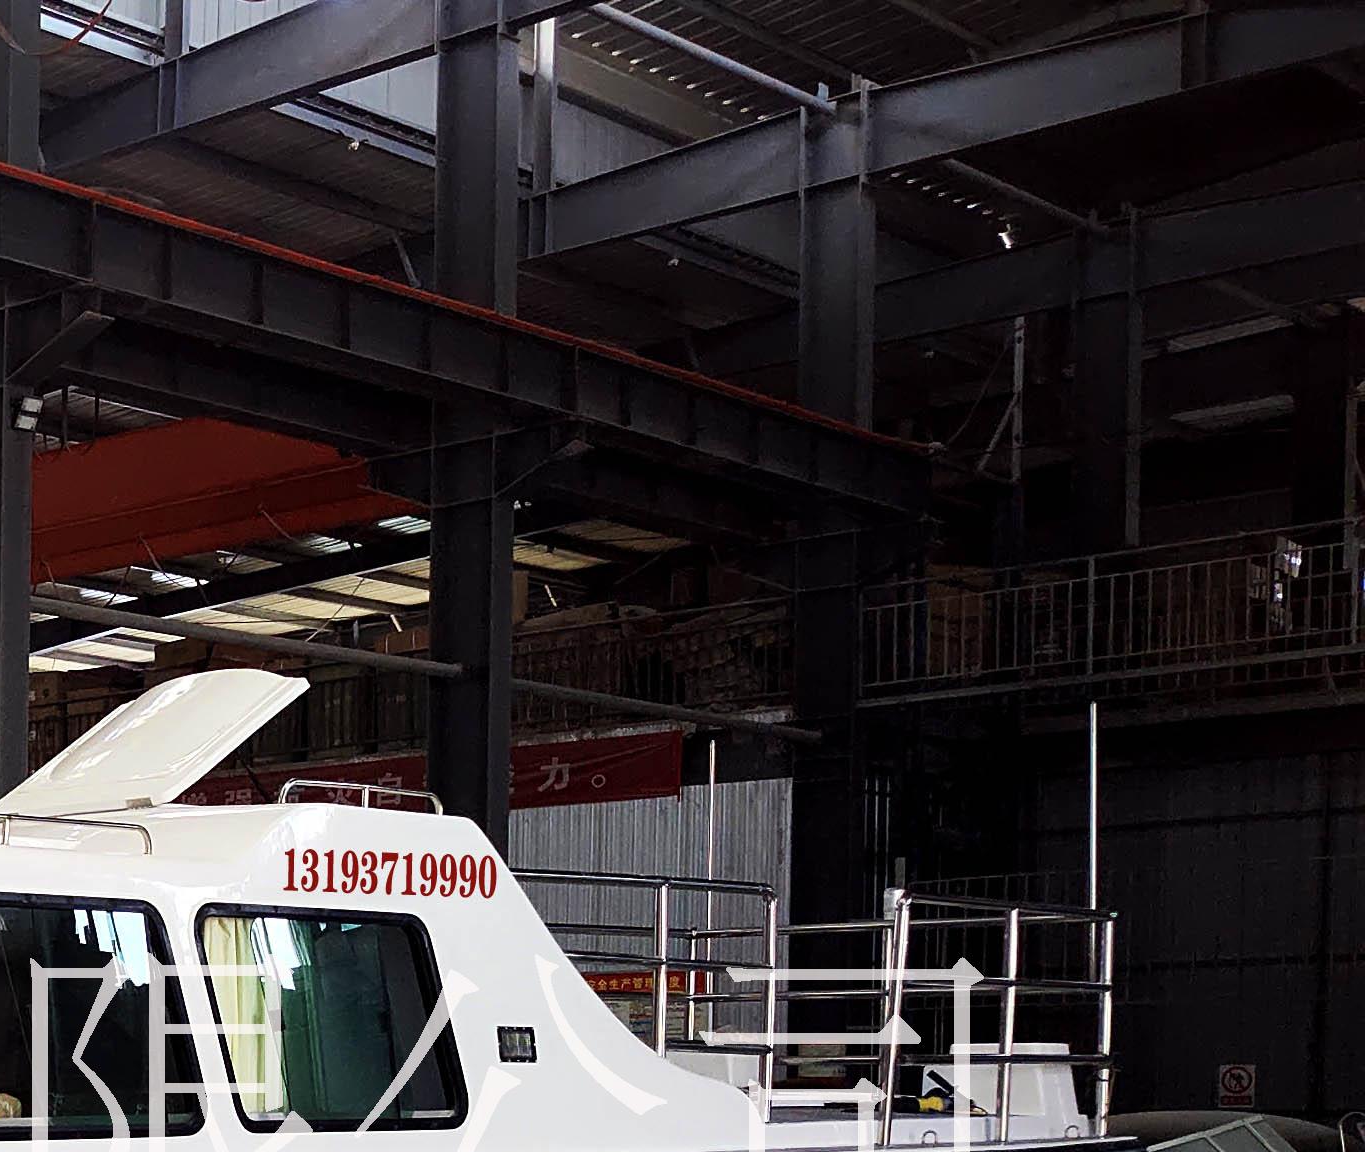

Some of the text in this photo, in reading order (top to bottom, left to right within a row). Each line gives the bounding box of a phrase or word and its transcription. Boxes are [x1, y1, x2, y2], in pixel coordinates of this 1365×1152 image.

[283, 848, 498, 899] 13193719990
[588, 975, 680, 991] 安全生产管理度
